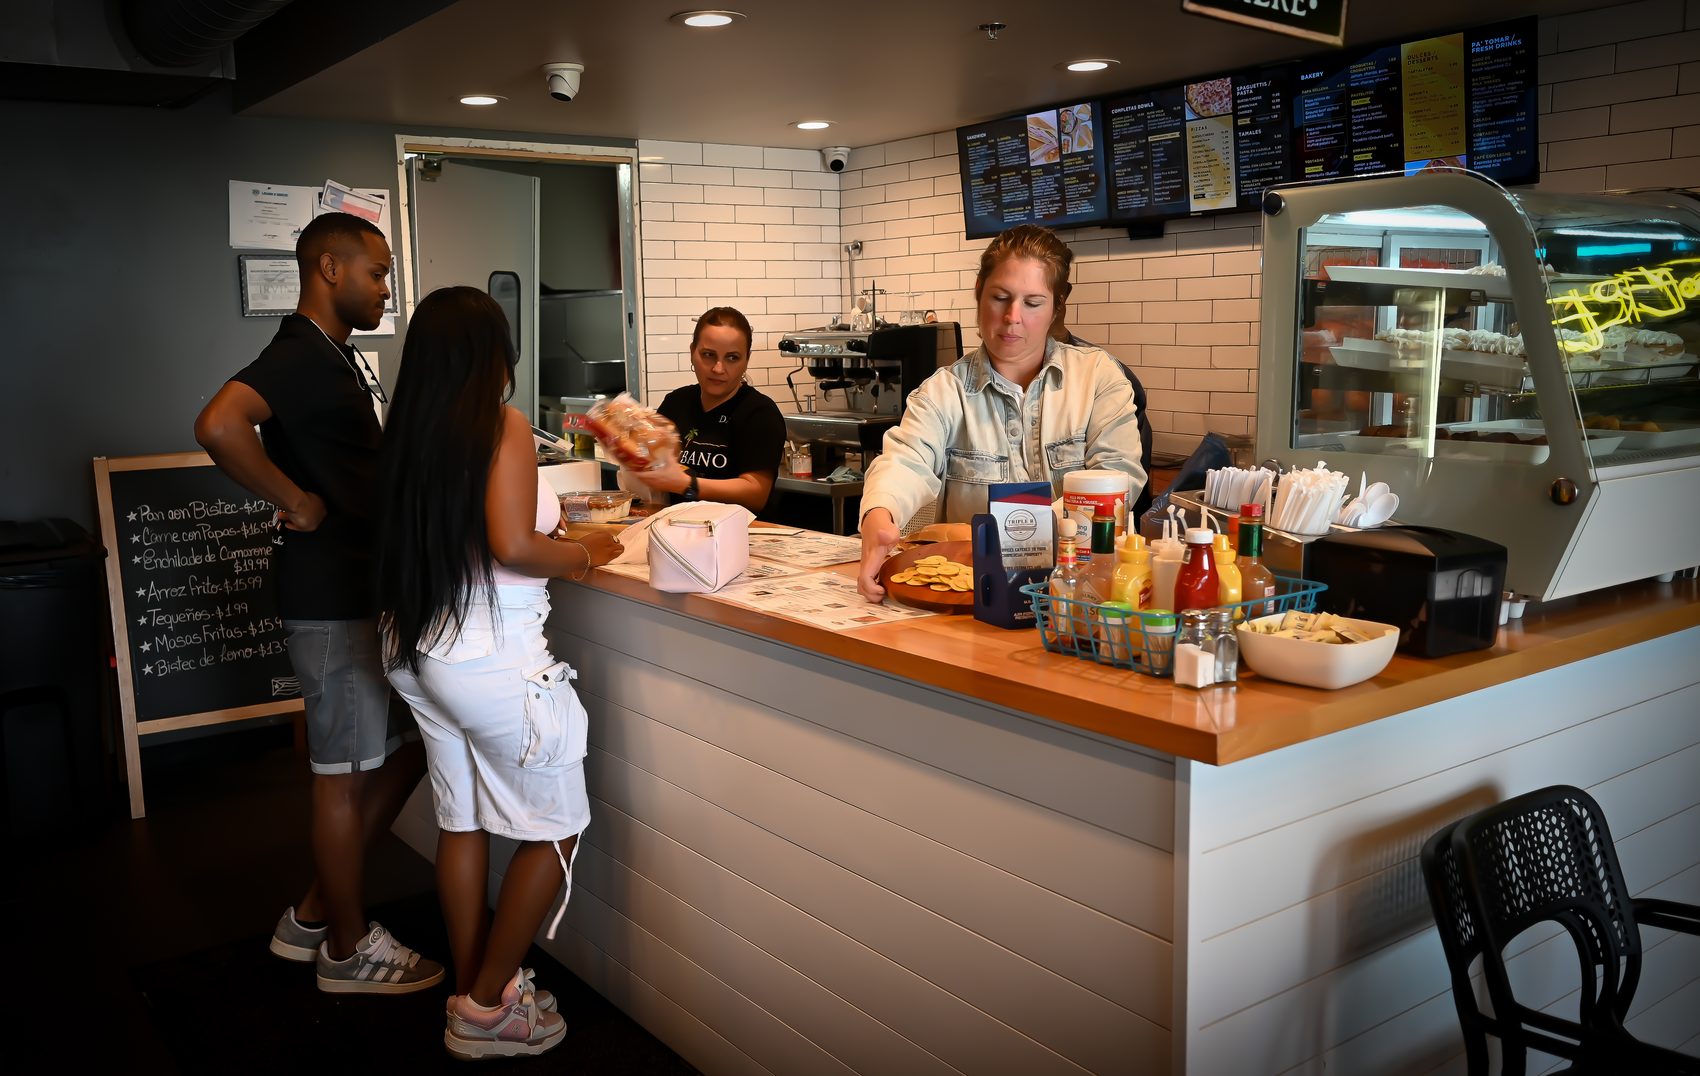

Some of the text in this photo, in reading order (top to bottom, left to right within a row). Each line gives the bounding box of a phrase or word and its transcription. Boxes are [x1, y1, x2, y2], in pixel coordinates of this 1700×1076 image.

[1472, 39, 1522, 54] FRESH DRINKS
[1484, 36, 1510, 45] TOMAR
[1407, 56, 1438, 66] DESSERTS
[1300, 72, 1324, 80] BAKERY
[1111, 105, 1137, 114] COMPLETAS
[967, 133, 986, 141] SANDWICH
[679, 450, 728, 469] BANO
[137, 504, 165, 522] Pan
[189, 499, 238, 520] Bistec
[143, 526, 181, 546] Carne
[182, 532, 202, 542] con
[205, 545, 216, 563] de
[234, 558, 269, 574] $19.99
[147, 580, 187, 603] Arroz
[202, 623, 243, 643] Fritas
[155, 656, 197, 677] Bistec
[199, 648, 216, 667] de
